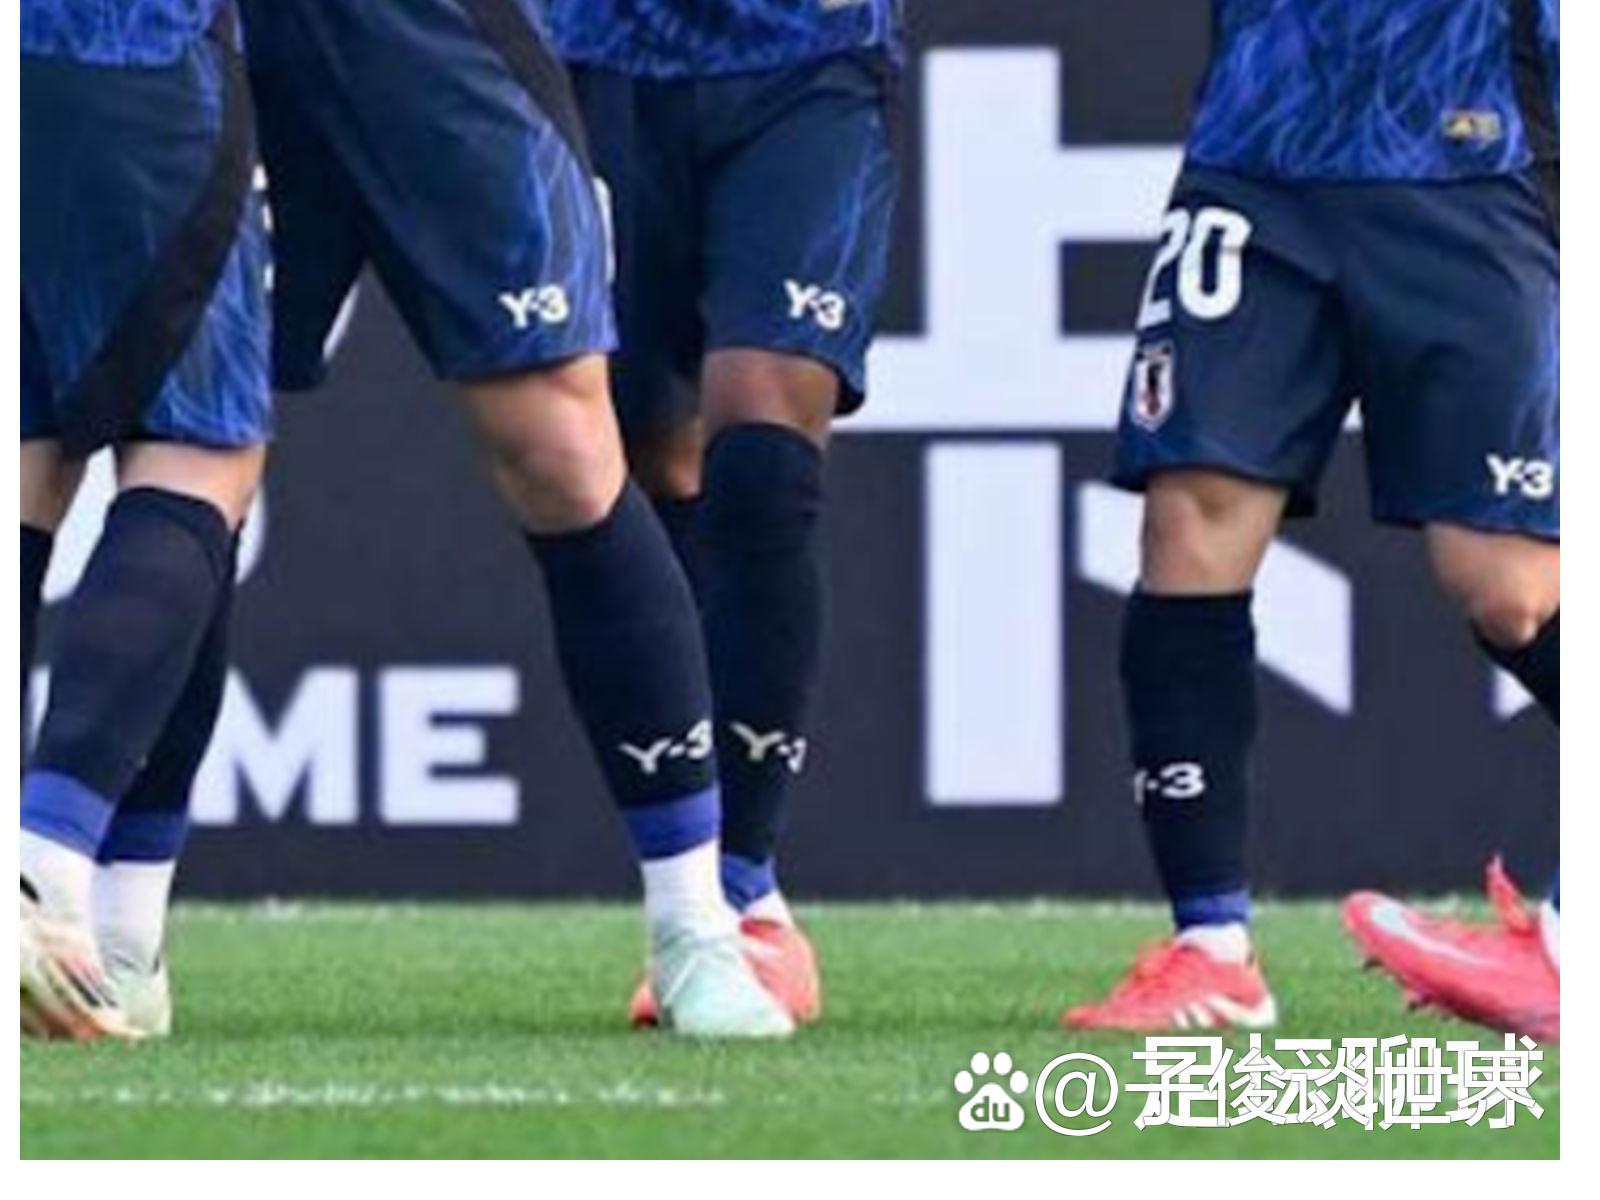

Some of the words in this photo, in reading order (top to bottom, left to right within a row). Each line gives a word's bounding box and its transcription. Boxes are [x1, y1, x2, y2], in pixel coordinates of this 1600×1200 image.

[1136, 206, 1253, 330] 20
[499, 284, 569, 329] Y-3
[783, 279, 845, 329] Y-3
[1486, 453, 1554, 498] Y-3
[618, 719, 713, 774] Y-3
